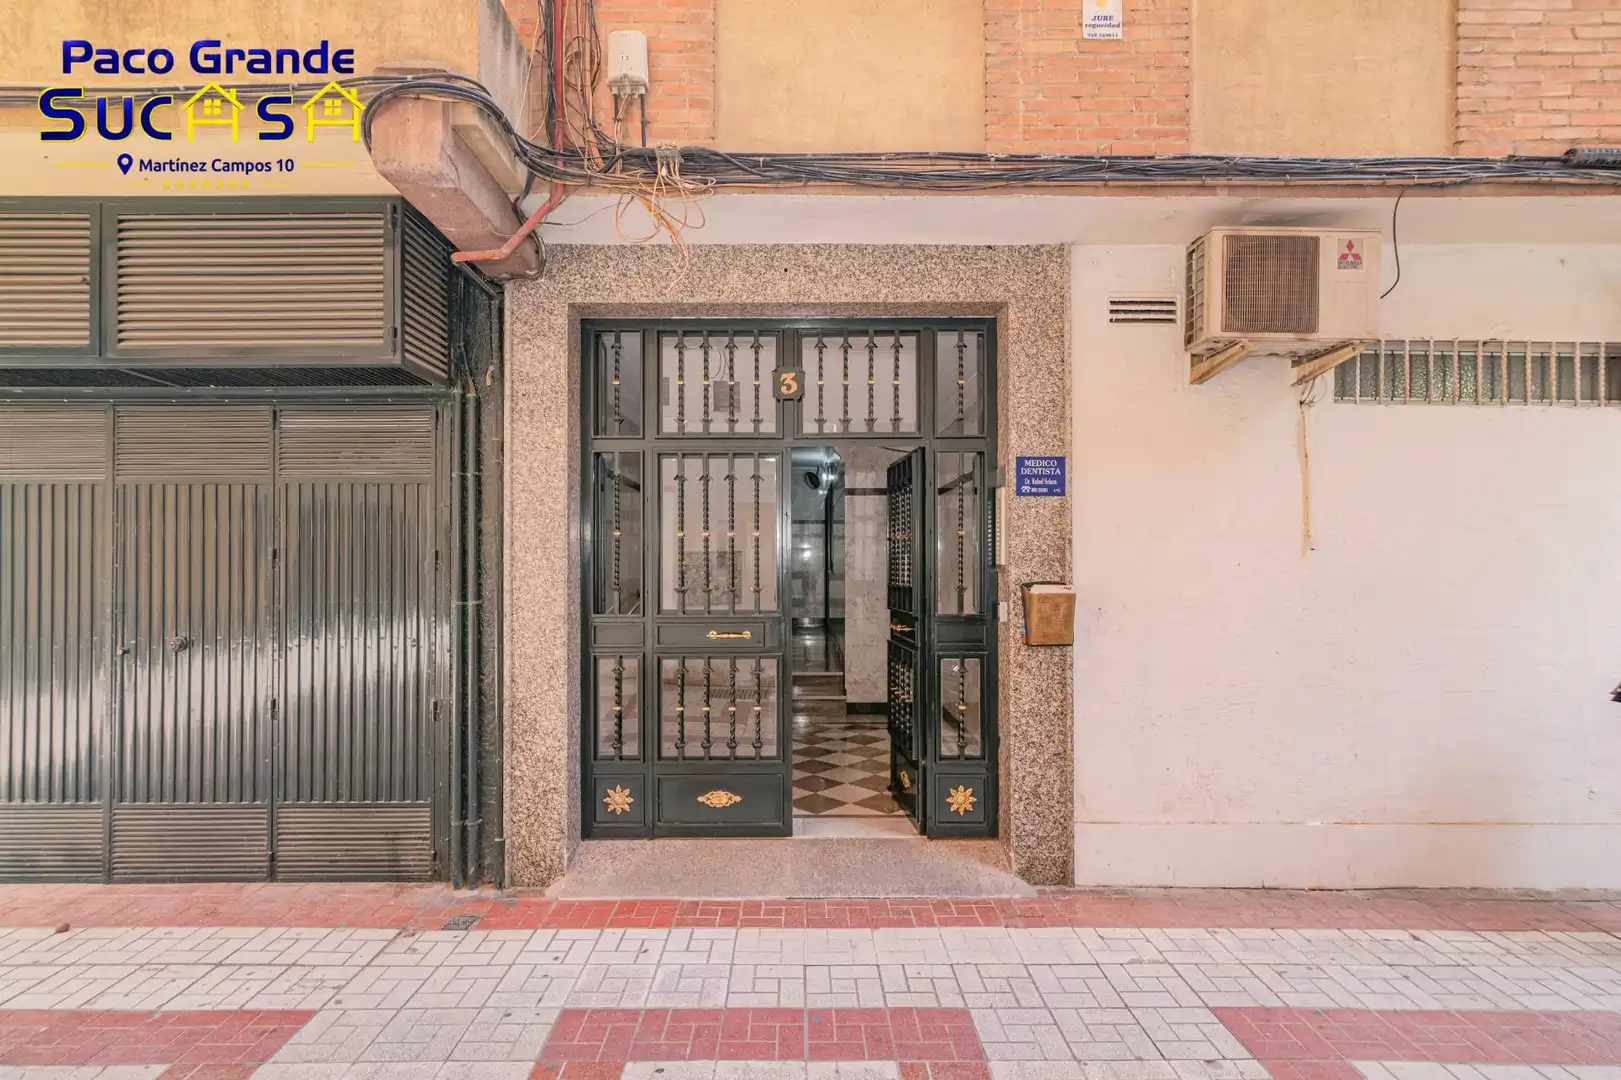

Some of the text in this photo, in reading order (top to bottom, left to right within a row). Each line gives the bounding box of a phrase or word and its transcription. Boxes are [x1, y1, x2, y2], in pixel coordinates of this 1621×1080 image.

[780, 371, 798, 395] 3
[1024, 459, 1057, 467] MEDICO
[1021, 467, 1061, 475] DENTISTA
